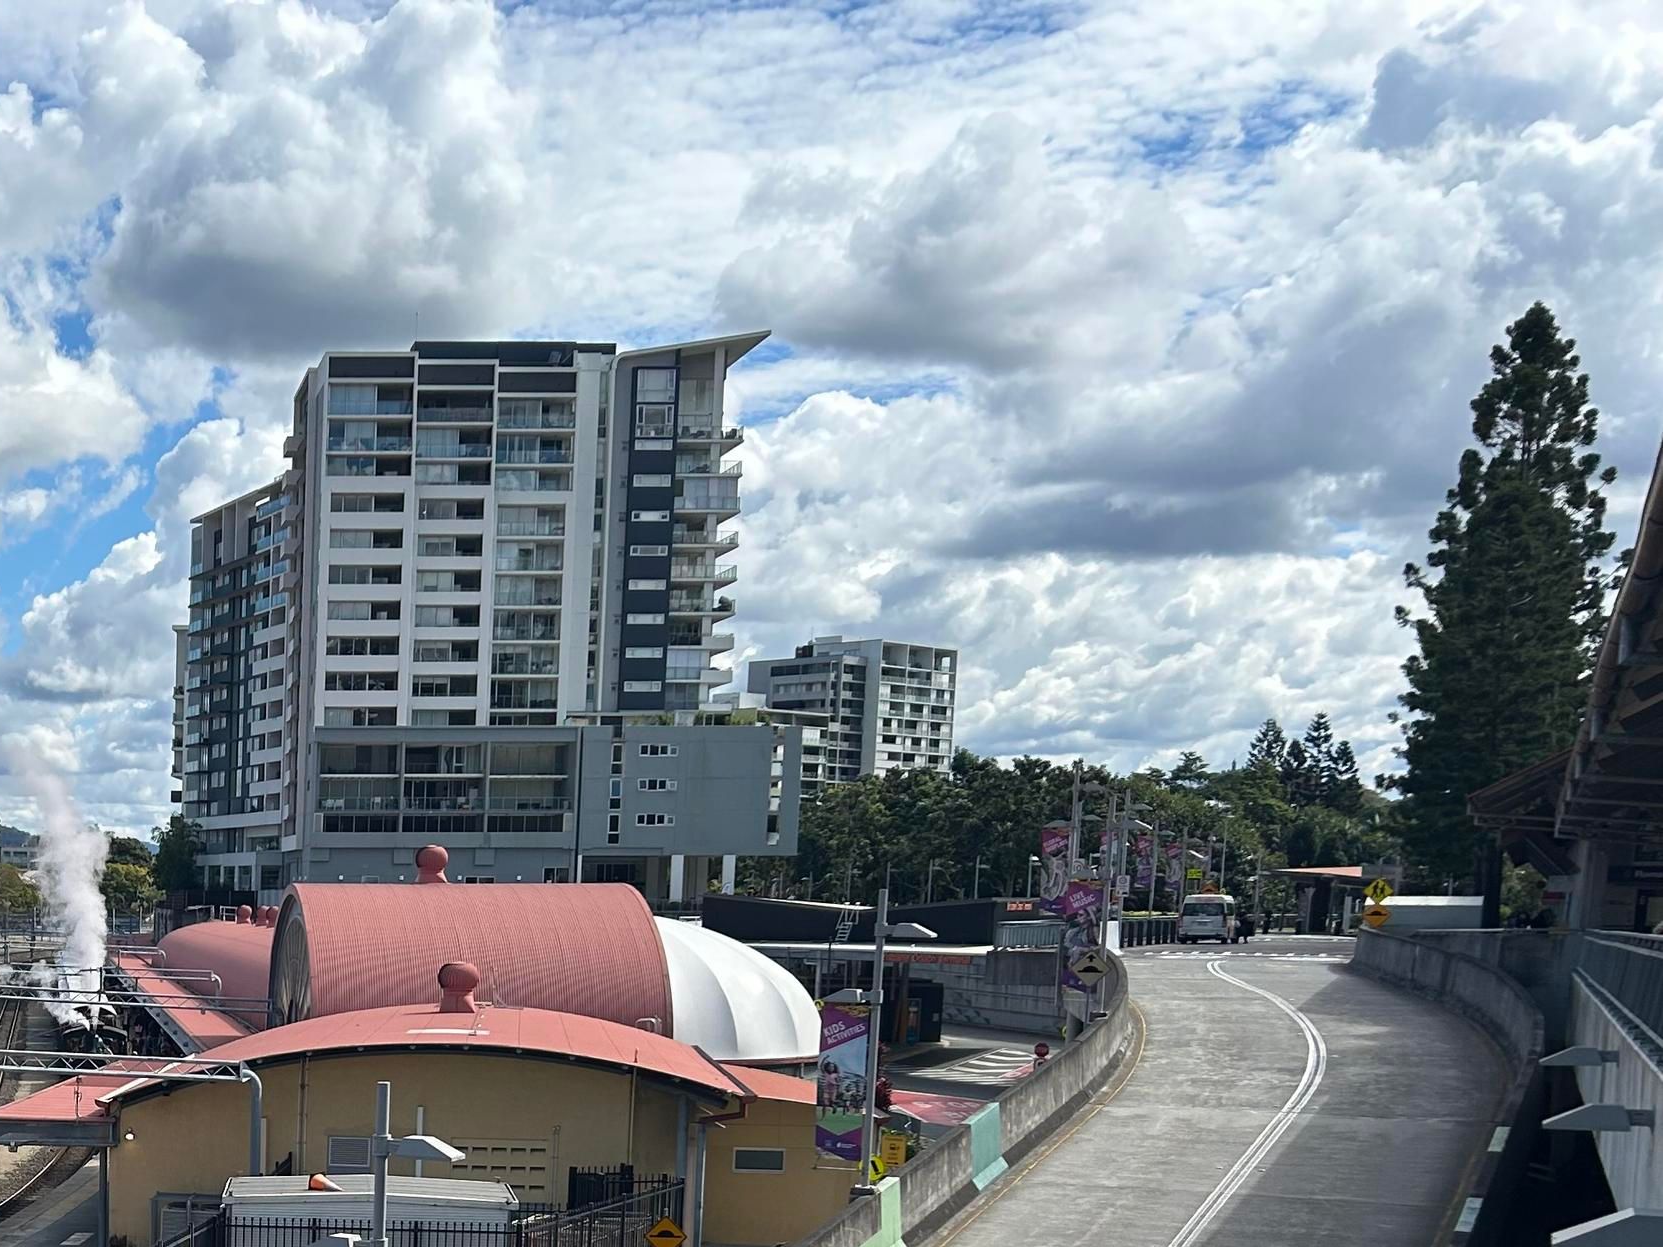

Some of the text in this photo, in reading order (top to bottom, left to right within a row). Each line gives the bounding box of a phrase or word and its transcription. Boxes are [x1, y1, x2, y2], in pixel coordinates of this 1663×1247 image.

[1069, 890, 1084, 903] LIVE
[1072, 894, 1096, 908] MUSIC
[824, 1020, 845, 1037] KIDS
[827, 1023, 866, 1045] ACTIVITIES
